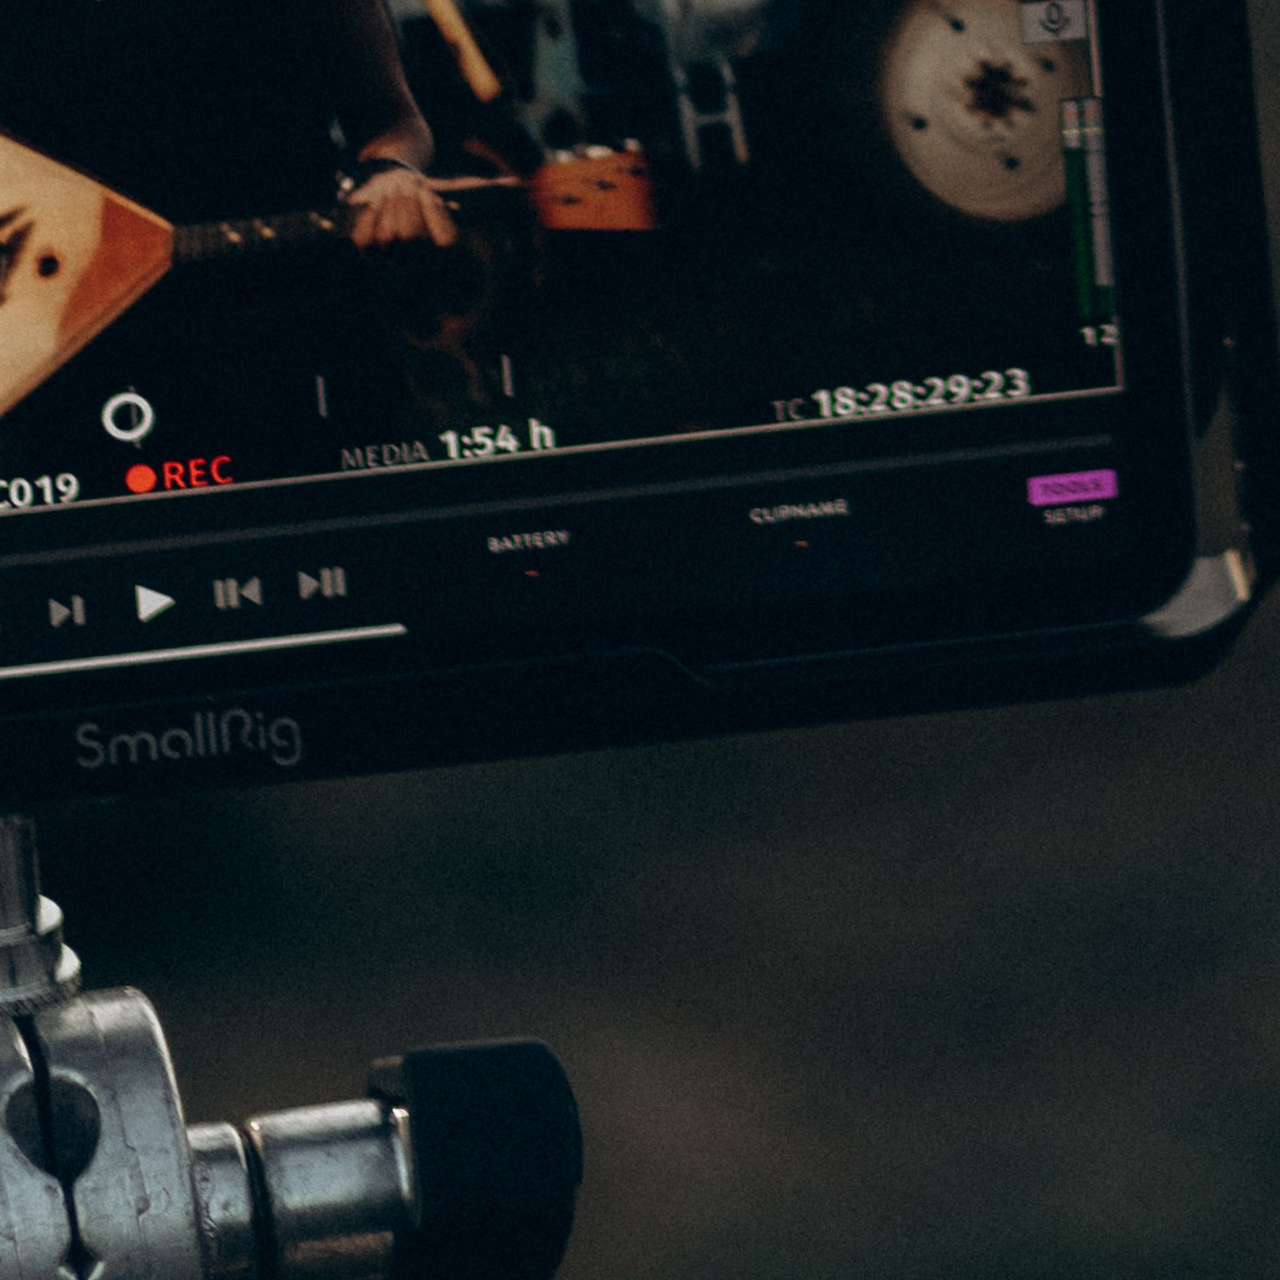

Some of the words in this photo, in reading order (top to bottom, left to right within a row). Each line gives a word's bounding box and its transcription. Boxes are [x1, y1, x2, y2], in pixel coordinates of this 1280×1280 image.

[772, 398, 806, 423] TC
[810, 367, 1032, 419] 18:28:29:23
[340, 440, 431, 471] MEDIA
[438, 423, 520, 460] 1:54
[528, 418, 556, 451] h
[162, 454, 234, 490] REC
[486, 529, 570, 554] BATTERY
[74, 708, 303, 769] SmallRig
